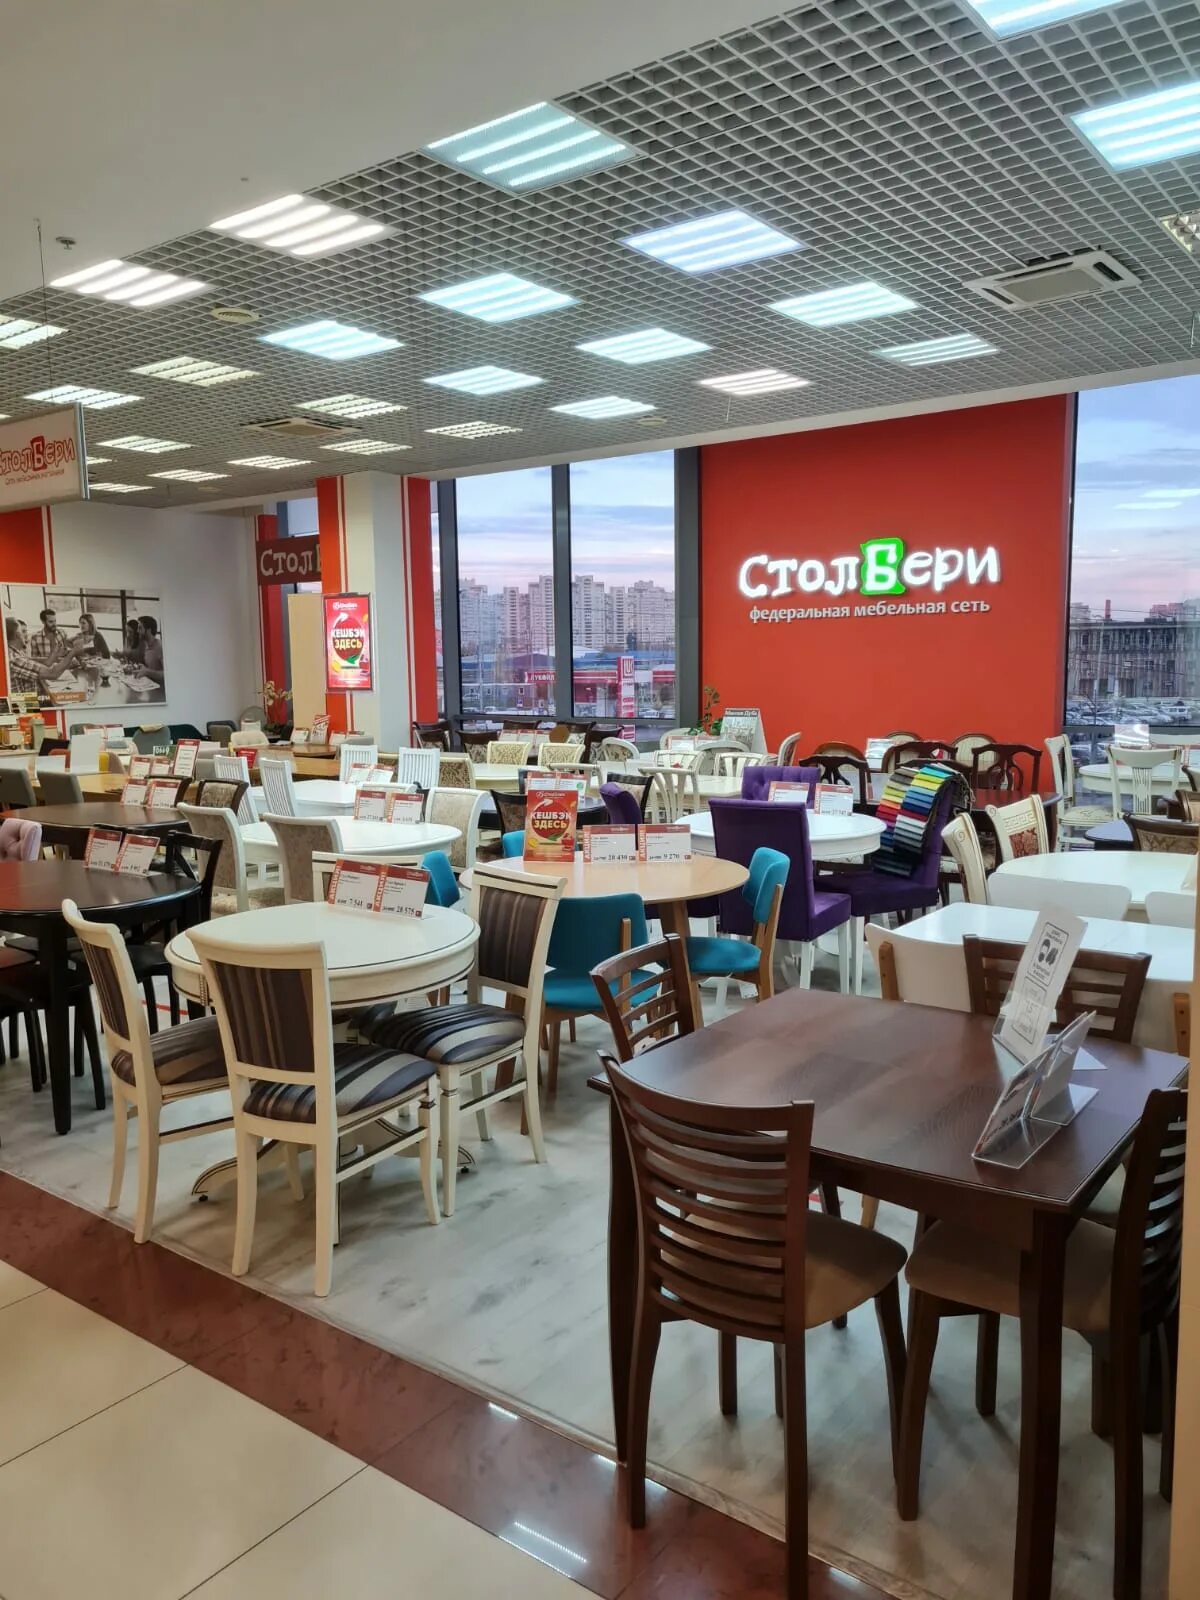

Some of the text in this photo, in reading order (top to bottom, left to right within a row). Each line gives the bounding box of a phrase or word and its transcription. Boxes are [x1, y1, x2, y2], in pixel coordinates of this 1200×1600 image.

[0, 436, 76, 475] толБери
[738, 541, 1000, 598] СтолБери
[749, 600, 991, 623] федеральная мебельная сеть
[334, 639, 363, 651] ЗДЕСЬ
[531, 811, 572, 820] КЕШБЭК
[534, 820, 567, 829] ЗДЕСЬ
